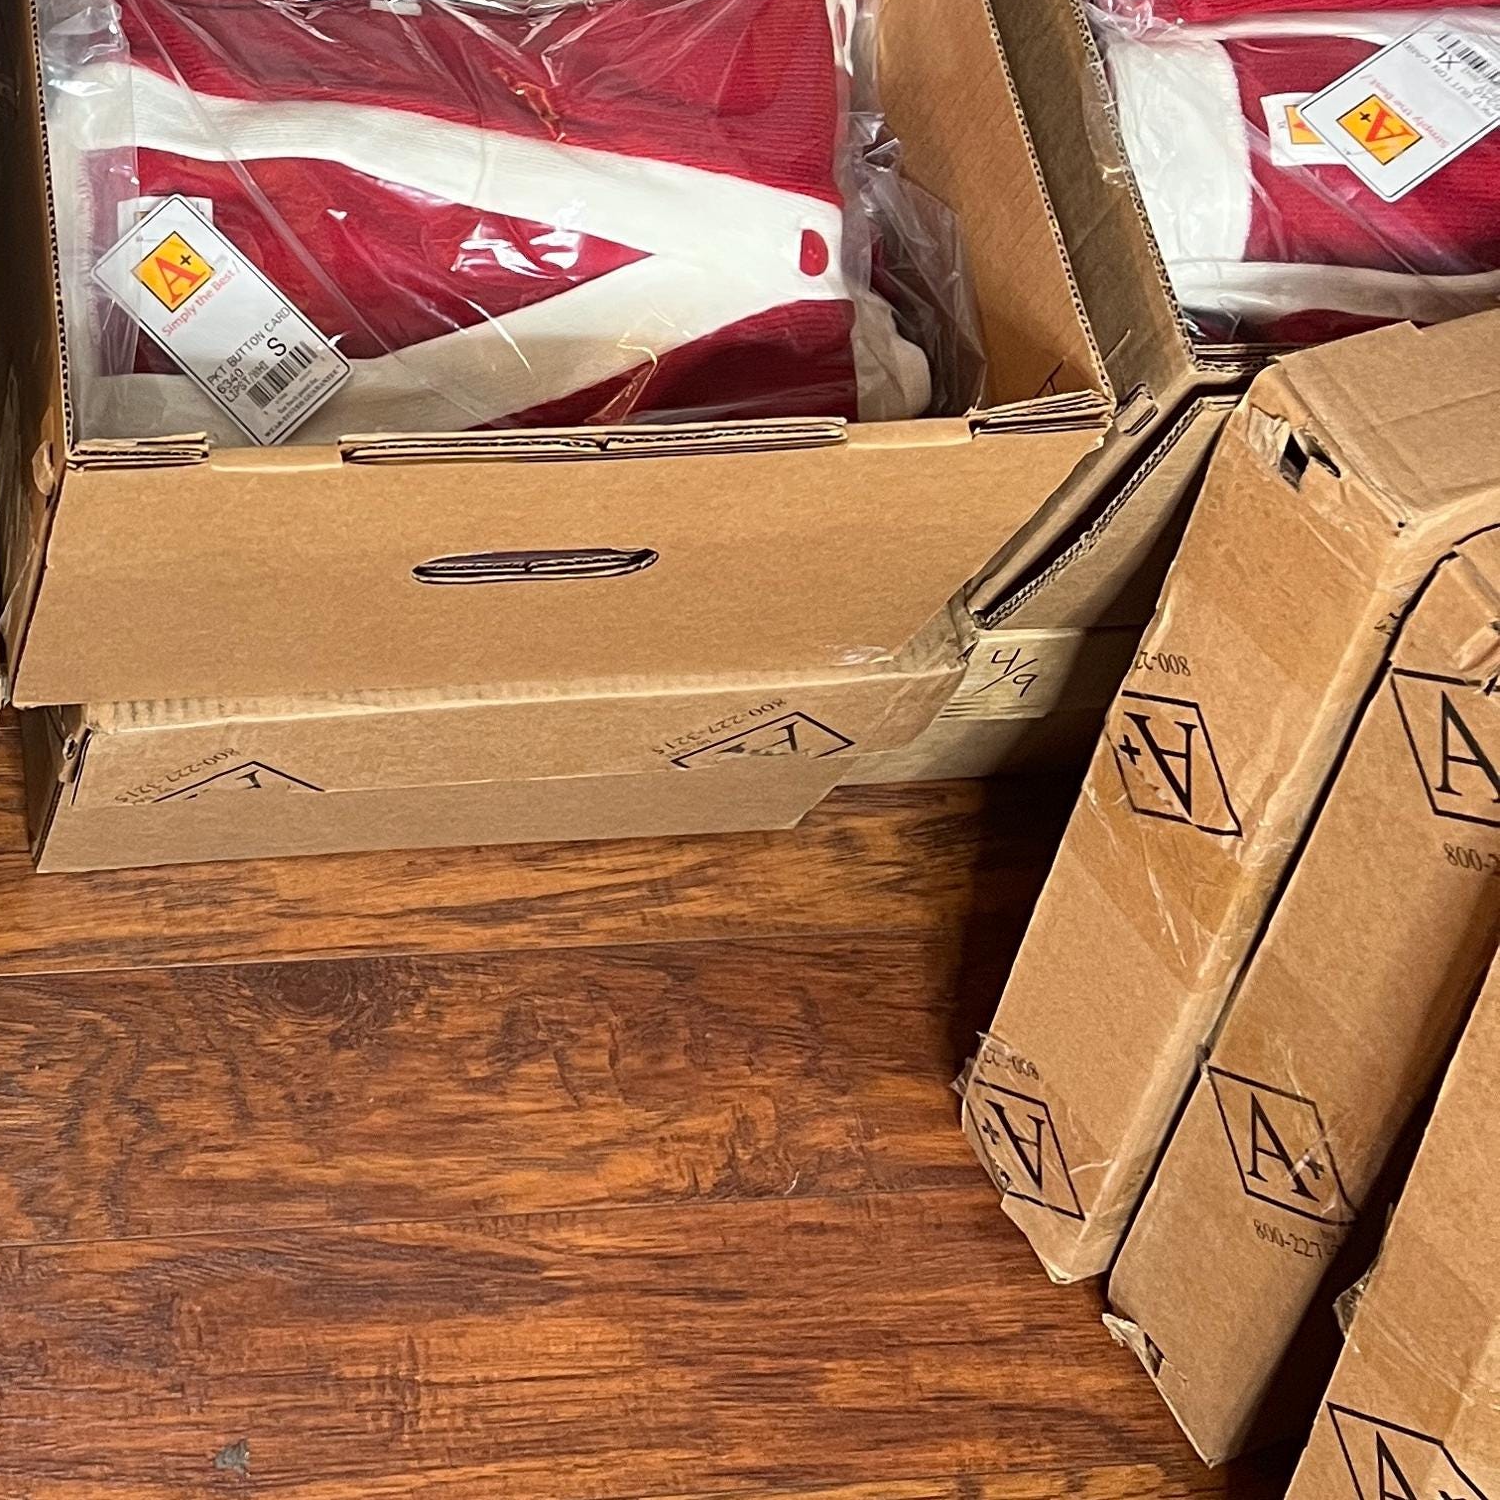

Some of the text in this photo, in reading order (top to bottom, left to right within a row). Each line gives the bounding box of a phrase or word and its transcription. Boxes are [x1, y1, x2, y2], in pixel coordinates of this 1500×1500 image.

[1430, 44, 1460, 72] XL
[1359, 102, 1414, 142] A+
[155, 254, 206, 304] A+
[162, 304, 197, 337] Simply
[195, 290, 214, 307] the
[206, 305, 291, 386] PKT BUTTON CARD
[265, 334, 288, 358] S
[215, 366, 245, 395] 6340
[1135, 651, 1192, 677] 800-22
[1119, 711, 1198, 818] A+
[1435, 690, 1500, 804] A
[981, 1099, 1046, 1194] A+
